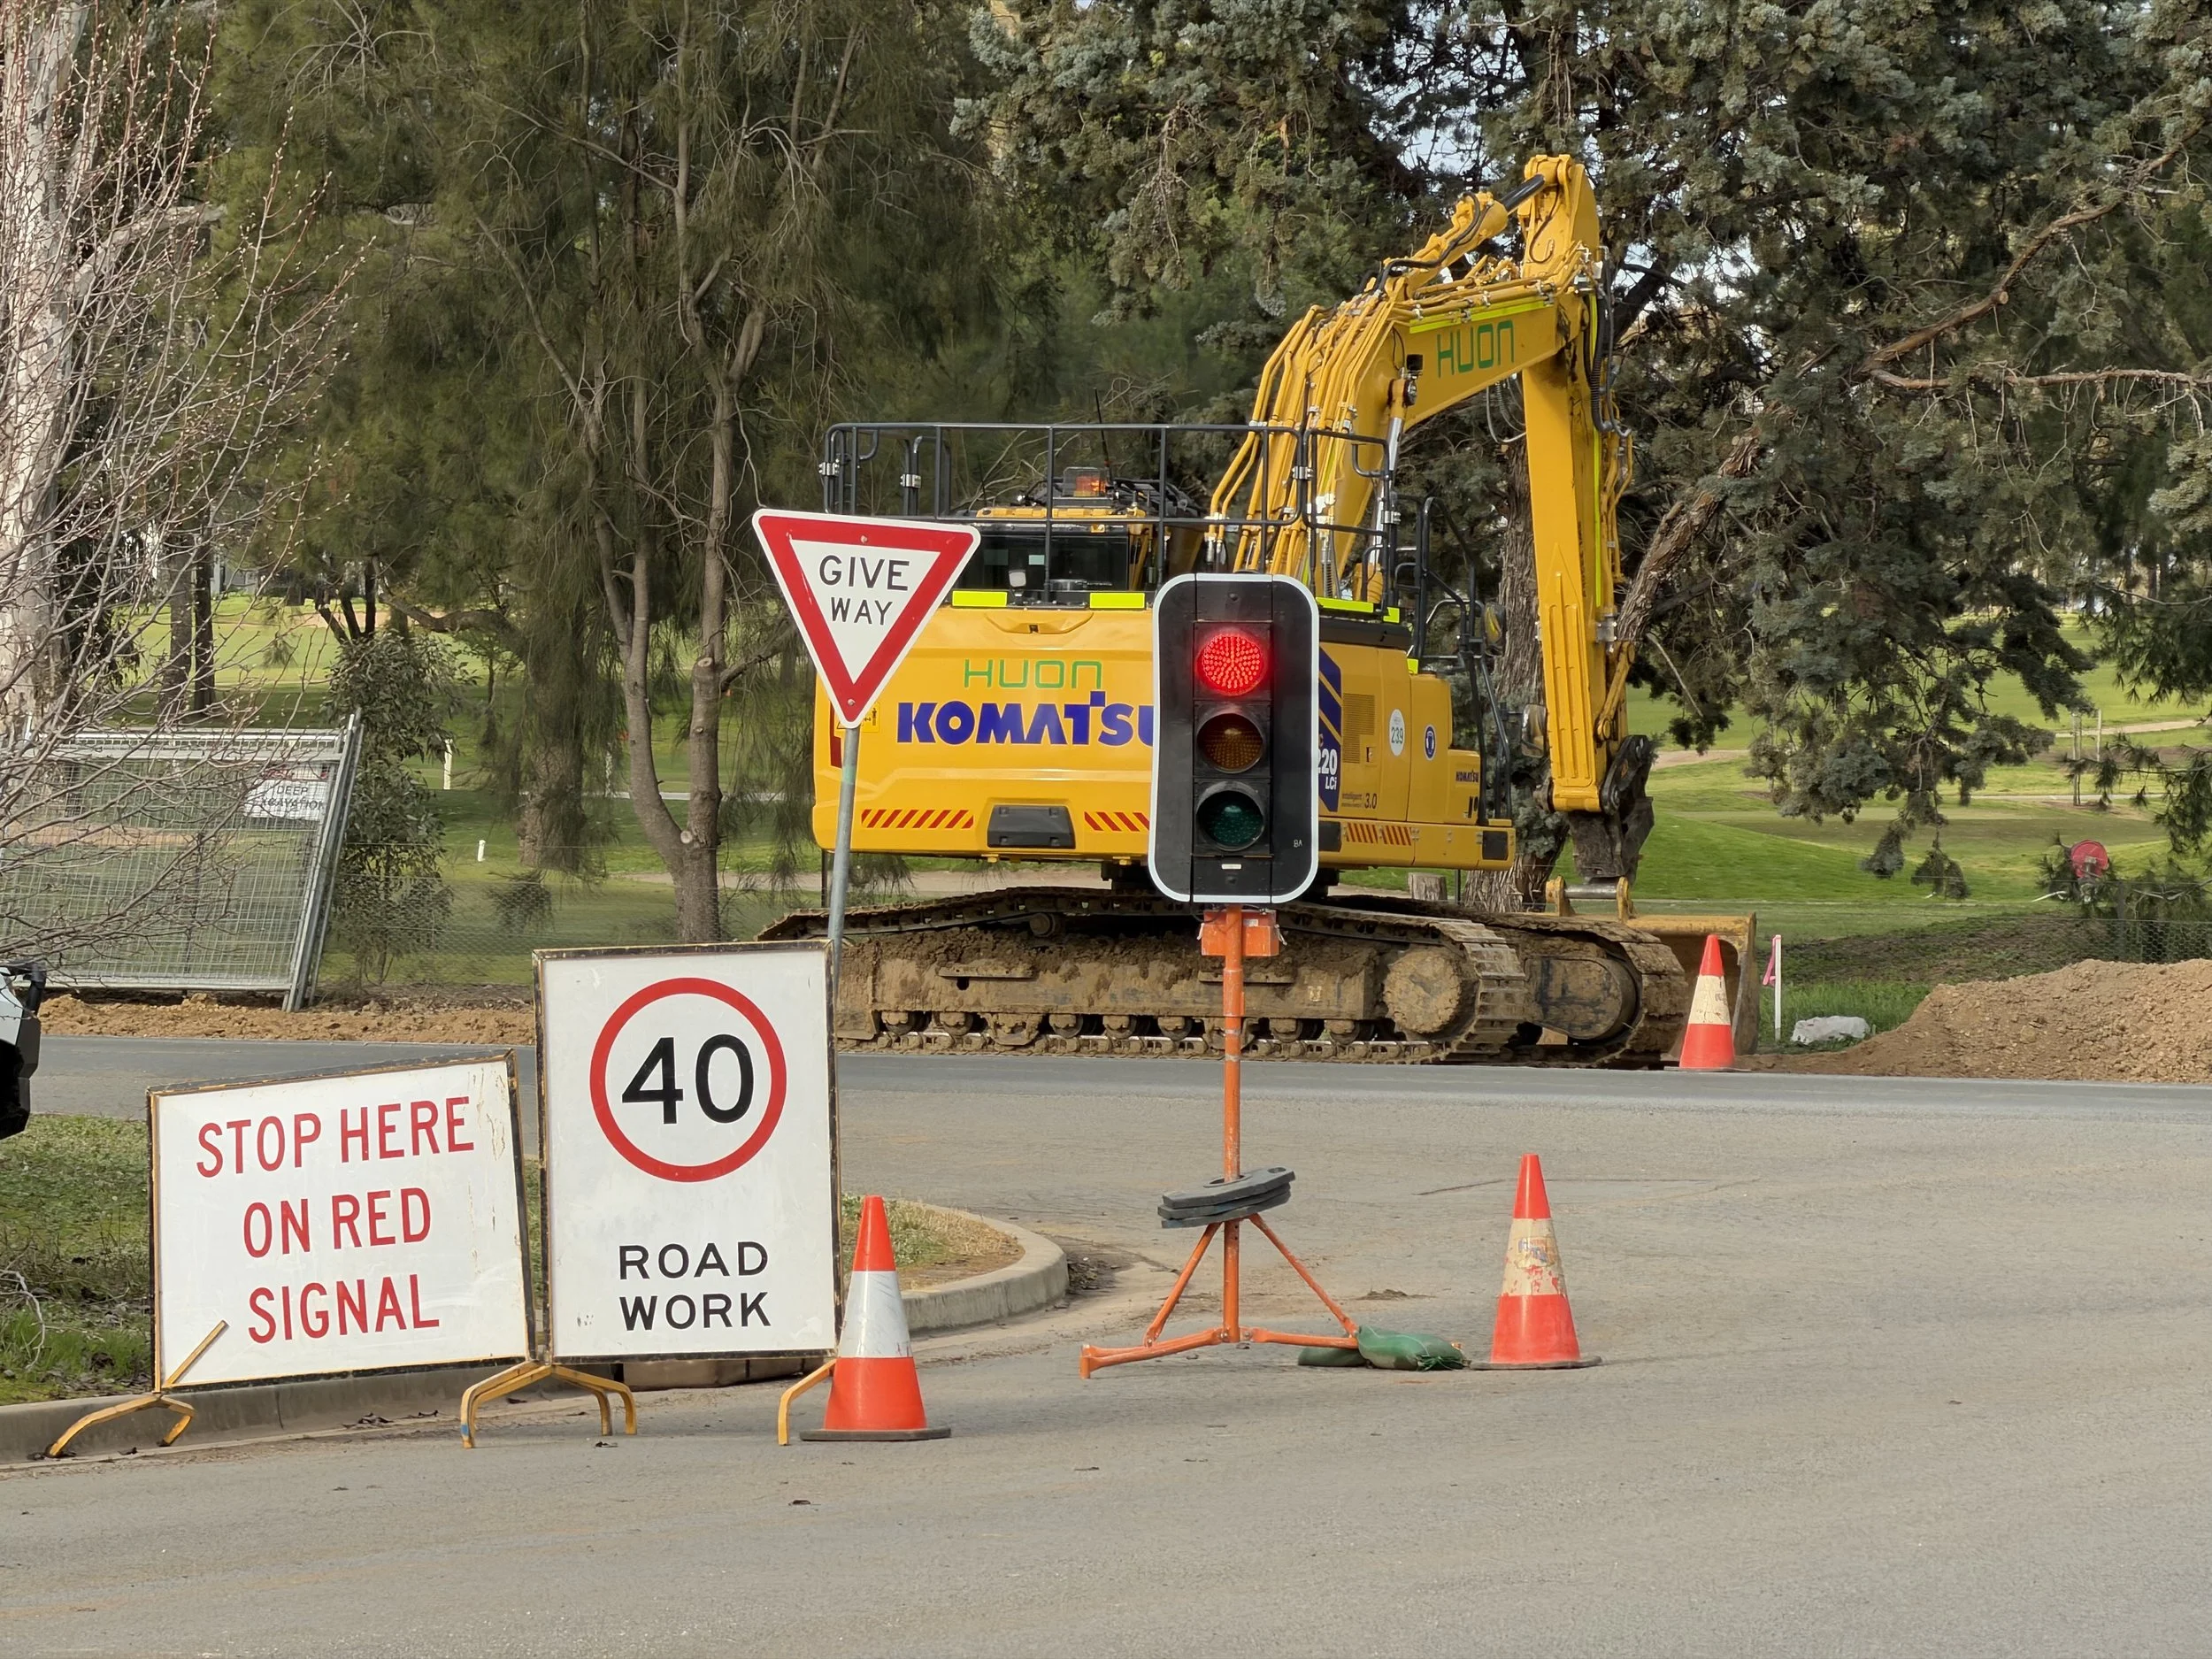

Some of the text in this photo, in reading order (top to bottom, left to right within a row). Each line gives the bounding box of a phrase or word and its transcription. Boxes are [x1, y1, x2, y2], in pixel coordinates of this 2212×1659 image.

[819, 555, 910, 591] GIVE
[831, 596, 893, 626] WAY
[1391, 726, 1403, 744] 239
[276, 785, 309, 795] DEEP
[1325, 776, 1337, 790] LCi
[1455, 768, 1479, 783] KOMATSU
[1364, 793, 1378, 809] 3.0
[621, 1033, 754, 1125] 40
[196, 1096, 474, 1178] STOP HERE
[243, 1187, 431, 1258] ON RED
[619, 1240, 768, 1280] ROAD
[248, 1274, 440, 1343] SIGNAL
[619, 1291, 771, 1332] WORK
